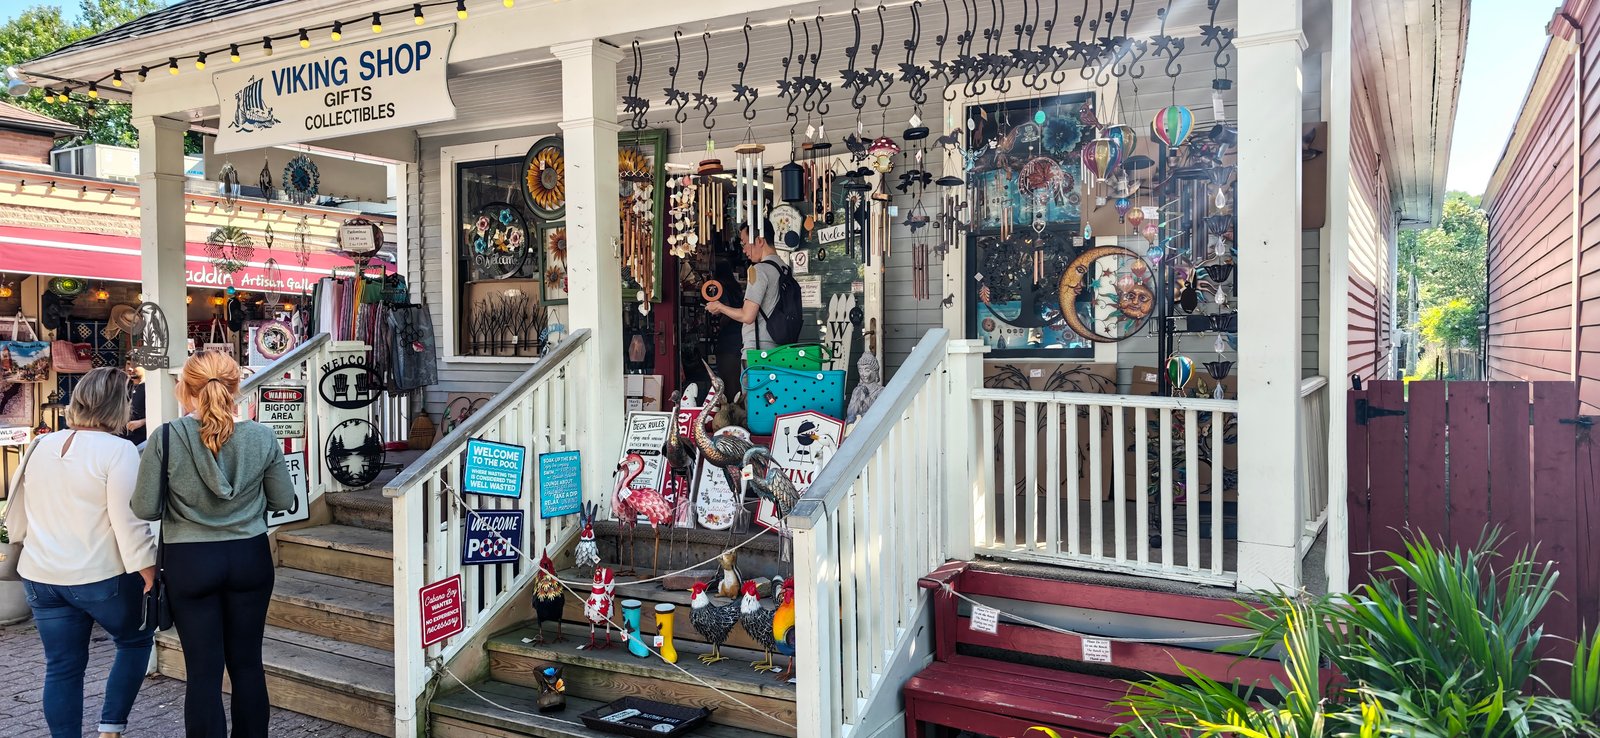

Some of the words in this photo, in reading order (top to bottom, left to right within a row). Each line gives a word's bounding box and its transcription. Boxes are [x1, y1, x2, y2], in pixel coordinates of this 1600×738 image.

[272, 57, 348, 96] VIKING
[359, 40, 432, 81] SHOP
[324, 86, 372, 107] GIFTS
[305, 102, 395, 130] COLLECTIBLES
[821, 227, 845, 241] Welco
[186, 266, 233, 284] addin
[241, 274, 284, 288] Artisan
[287, 277, 314, 291] Galle
[321, 354, 380, 374] WELCO
[268, 391, 297, 399] WARNING
[265, 403, 300, 411] BIGFOOT
[271, 412, 293, 420] AREA
[633, 423, 647, 431] DECK
[648, 420, 665, 428] RULES
[473, 445, 519, 461] WELCOME
[473, 456, 483, 464] TO
[484, 457, 498, 467] THE
[499, 460, 518, 469] POOL
[470, 480, 488, 489] WELL
[490, 482, 516, 491] WASTED
[476, 475, 506, 483] CONSIDERED
[470, 516, 519, 531] WELCOME
[467, 538, 515, 559] POOL
[424, 593, 446, 607] Cabana
[446, 587, 457, 598] Boy
[431, 598, 453, 611] WANTED
[433, 608, 459, 622] EXPERIENCE
[426, 616, 459, 635] necessary
